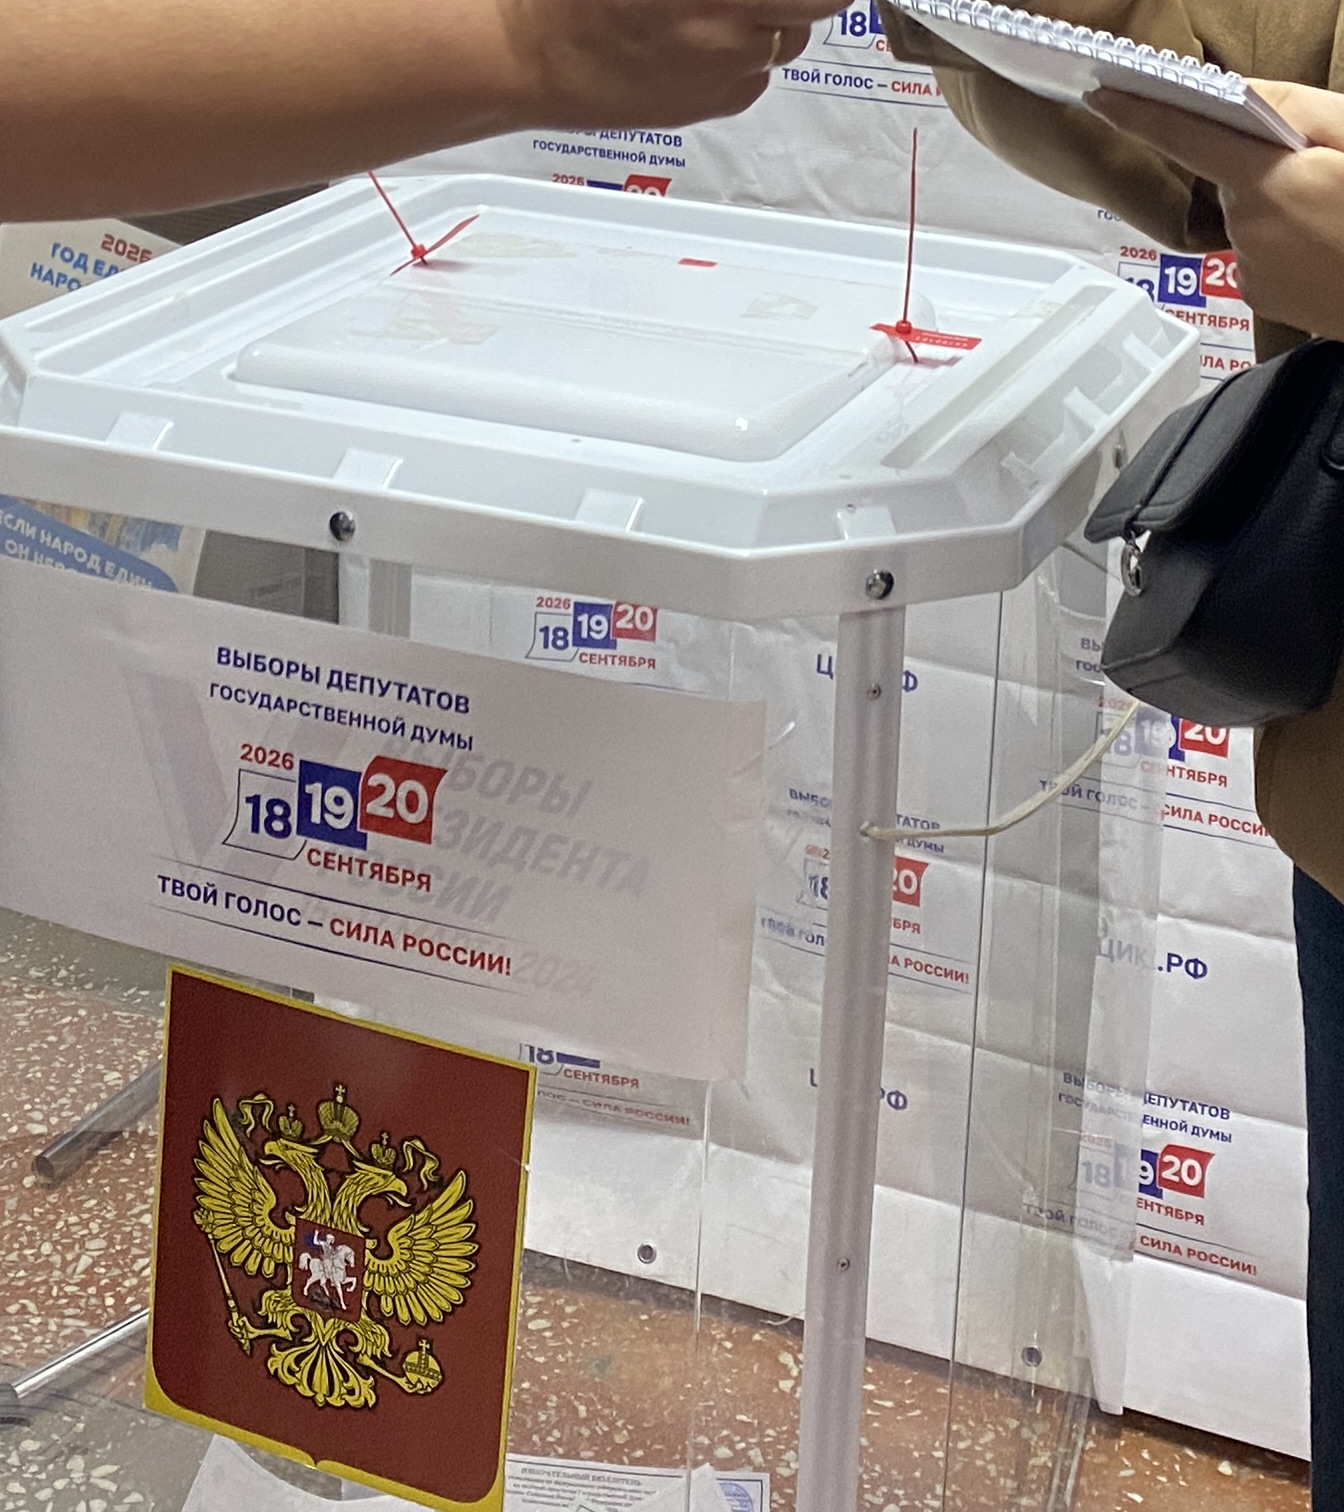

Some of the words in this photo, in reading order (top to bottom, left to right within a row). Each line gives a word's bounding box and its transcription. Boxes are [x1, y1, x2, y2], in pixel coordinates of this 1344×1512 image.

[838, 11, 867, 37] 18
[782, 68, 820, 83] ТВОЙ
[825, 73, 874, 90] ГОЛОС
[891, 80, 933, 96] СИЛА
[600, 130, 682, 147] ДЕПУТАТОВ
[533, 139, 646, 163] ГОСУДАРСТВЕННОЙ
[649, 156, 685, 167] ДУМЫ
[552, 173, 585, 186] 2026
[51, 242, 89, 274] ГОД
[101, 233, 153, 263] 2026
[1120, 246, 1157, 261] 2026
[30, 262, 81, 292] НАРО
[1164, 266, 1198, 296] 19
[5, 539, 29, 559] ОН
[40, 528, 102, 573] НАРОД
[536, 596, 571, 610] 2026
[539, 626, 569, 650] 18
[577, 614, 608, 640] 19
[616, 604, 654, 631] 20
[579, 652, 656, 669] СЕНТЯБРЯ
[217, 647, 320, 685] ВЫБОРЫ
[326, 668, 470, 714] ДЕПУТАТОВ
[209, 682, 406, 738] ГОСУДАРСТВЕННОЙ
[410, 724, 473, 751] ДУМЫ
[240, 743, 295, 770] 2026
[245, 794, 292, 839] 18
[305, 782, 353, 831] 19
[366, 773, 429, 825] 20
[1208, 814, 1271, 837] РОССИ
[307, 847, 431, 892] СЕНТЯБРЯ
[157, 874, 217, 907] ТВОЙ
[224, 892, 301, 927] ГОЛОС
[329, 917, 395, 949] СИЛА
[402, 934, 511, 976] РОССИИ!
[904, 958, 969, 984] РОССИИ!
[564, 1068, 639, 1089] СЕНТЯБРЯ
[1191, 1125, 1232, 1143] ДУМЫ
[1162, 1154, 1202, 1187] 20
[1136, 1198, 1205, 1226] ЕНТЯБРЯ
[1140, 1236, 1182, 1257] СИЛА
[1187, 1248, 1257, 1276] РОССИИ!
